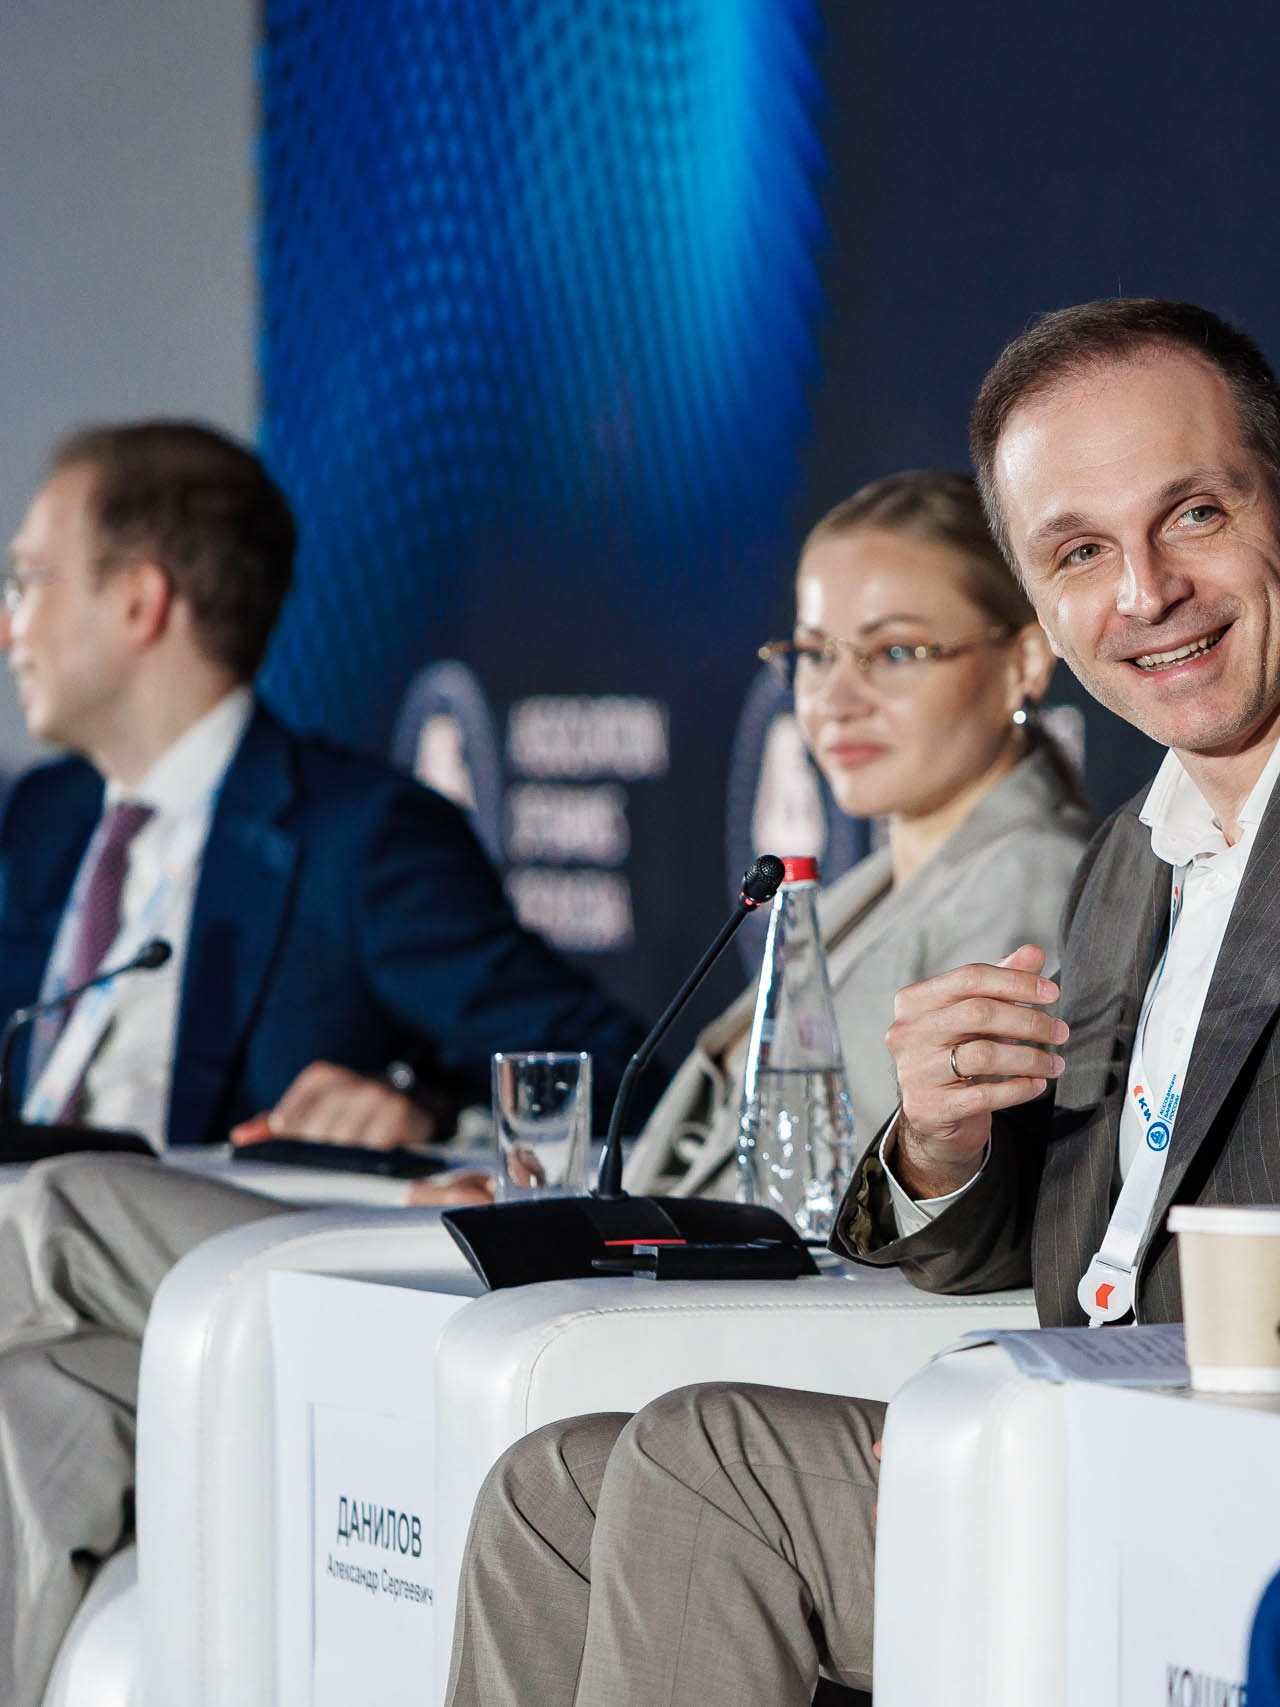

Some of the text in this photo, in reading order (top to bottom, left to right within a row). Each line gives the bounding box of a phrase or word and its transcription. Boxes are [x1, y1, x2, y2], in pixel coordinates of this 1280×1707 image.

[337, 1496, 422, 1557] ДАНИЛОВ
[327, 1551, 434, 1607] Александр Сергеевич
